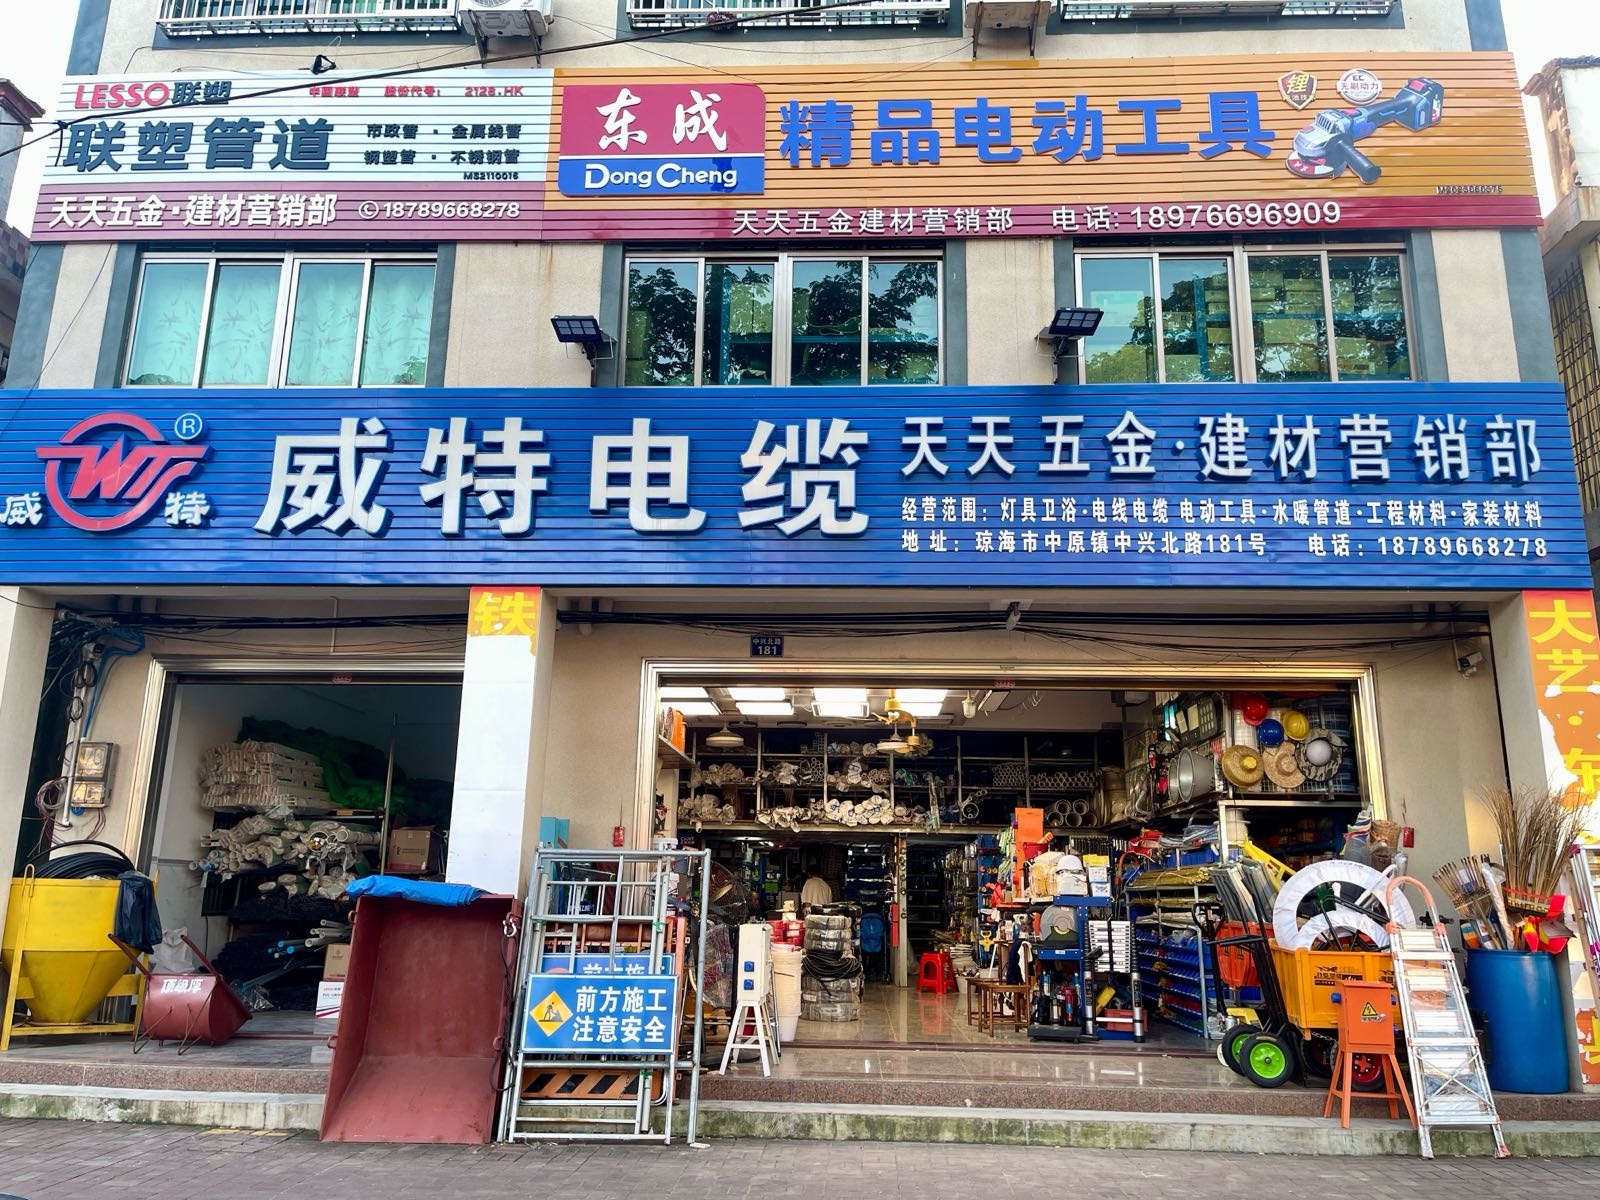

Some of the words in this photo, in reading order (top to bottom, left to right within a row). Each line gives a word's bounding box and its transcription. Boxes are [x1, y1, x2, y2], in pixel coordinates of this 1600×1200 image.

[74, 83, 171, 109] LESSO
[464, 86, 525, 98] 2128.HK
[1286, 73, 1310, 94] 锂
[1352, 74, 1365, 82] EC
[595, 87, 729, 153] 东成
[779, 91, 1276, 168] 精品电动工具
[62, 117, 335, 173] 联塑管道
[48, 192, 338, 229] 天天五金·建材营销部
[383, 200, 521, 221] 18789668278
[732, 205, 1014, 236] 天天五金建材营销部
[1130, 200, 1342, 230] 18976696909
[900, 409, 1543, 484] 天天五金·建材营销部
[252, 416, 871, 538] 威特电缆
[0, 490, 43, 526] 威
[164, 490, 211, 527] 特
[757, 645, 778, 655] 181
[575, 985, 668, 1014] 前方施工
[572, 1015, 667, 1044] 注意安全
